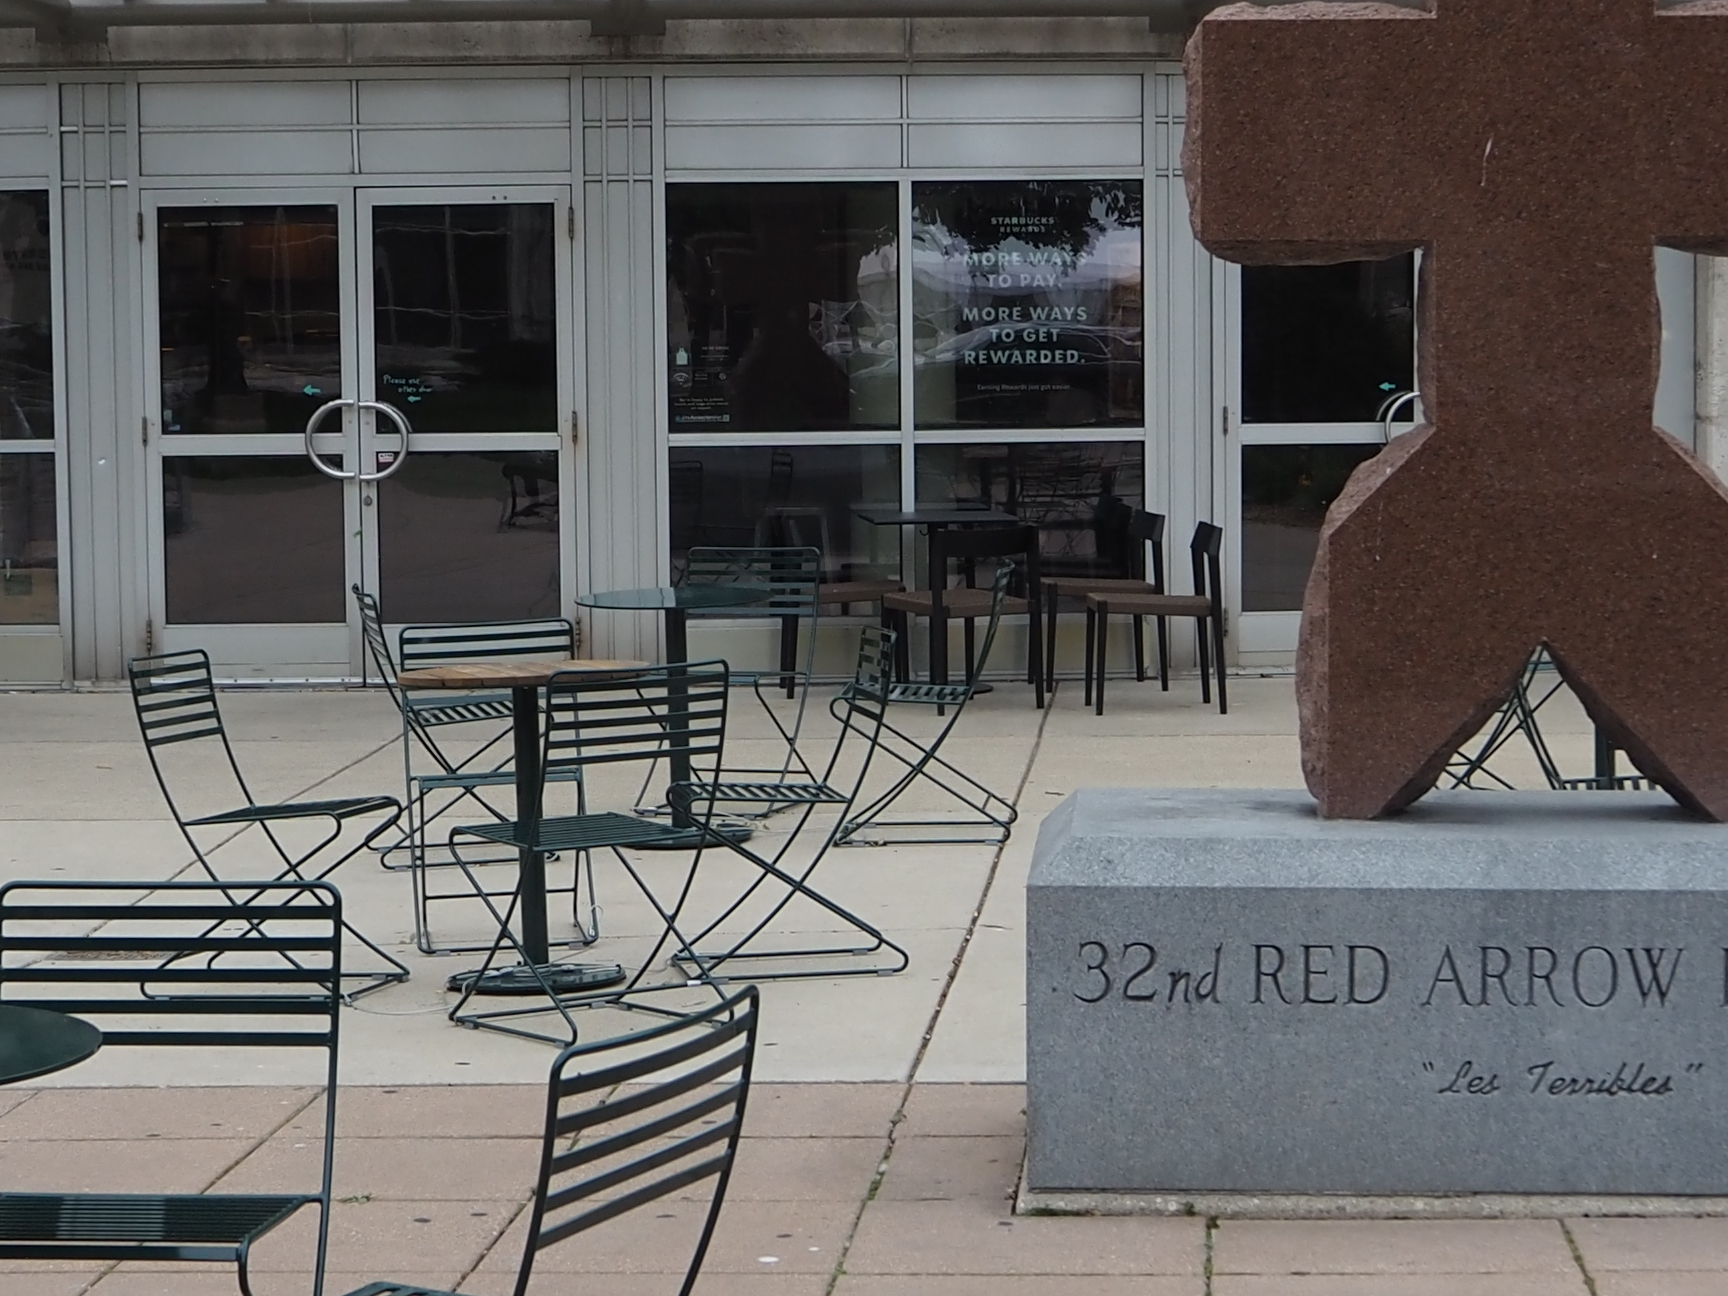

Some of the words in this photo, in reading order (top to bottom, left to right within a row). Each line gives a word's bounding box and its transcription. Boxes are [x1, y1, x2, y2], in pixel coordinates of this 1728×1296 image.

[990, 216, 1055, 225] STARBUCKS
[963, 252, 1021, 266] MORE
[1028, 252, 1087, 266] WAYS
[988, 273, 1012, 287] TO
[962, 306, 1022, 321] MORE
[1028, 306, 1088, 321] WAYS
[989, 328, 1015, 342] TO
[1022, 328, 1060, 342] GET
[963, 349, 1086, 364] REWARDED.
[383, 374, 405, 384] Please
[1072, 940, 1222, 1006] 32nd
[1250, 944, 1392, 1008] RED
[1424, 945, 1686, 1009] ARROW
